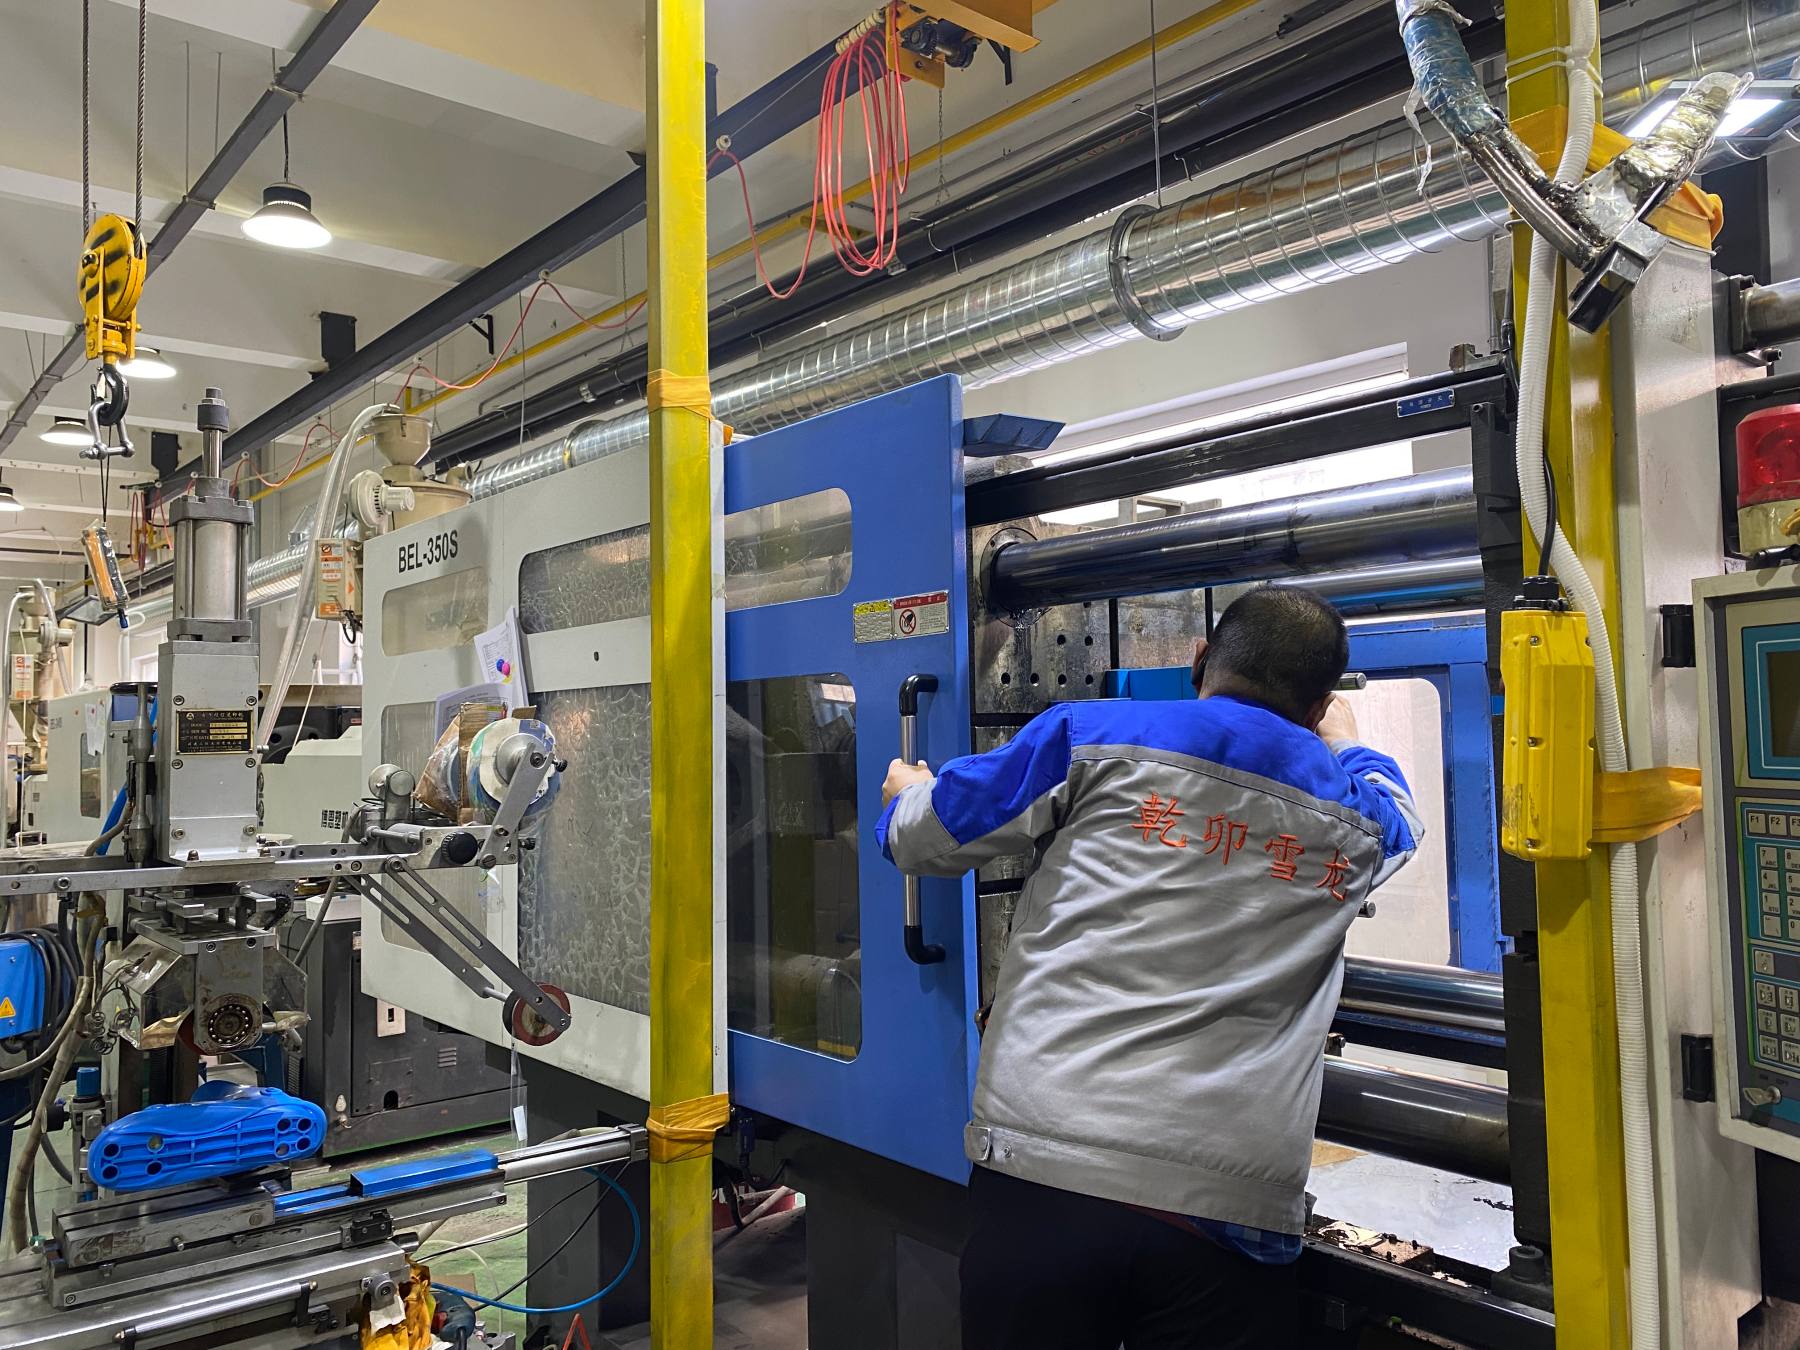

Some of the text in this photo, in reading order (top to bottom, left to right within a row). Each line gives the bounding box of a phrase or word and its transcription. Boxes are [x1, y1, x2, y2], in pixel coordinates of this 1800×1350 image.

[398, 529, 458, 574] BEL-350S
[1750, 815, 1760, 824] F1
[1770, 817, 1781, 825] F2
[1131, 791, 1352, 902] 乾卯雪龙
[1761, 849, 1767, 857] 7
[1763, 873, 1768, 881] 4
[1788, 875, 1793, 884] 5
[1789, 898, 1795, 907] 2
[1790, 920, 1796, 929] 0
